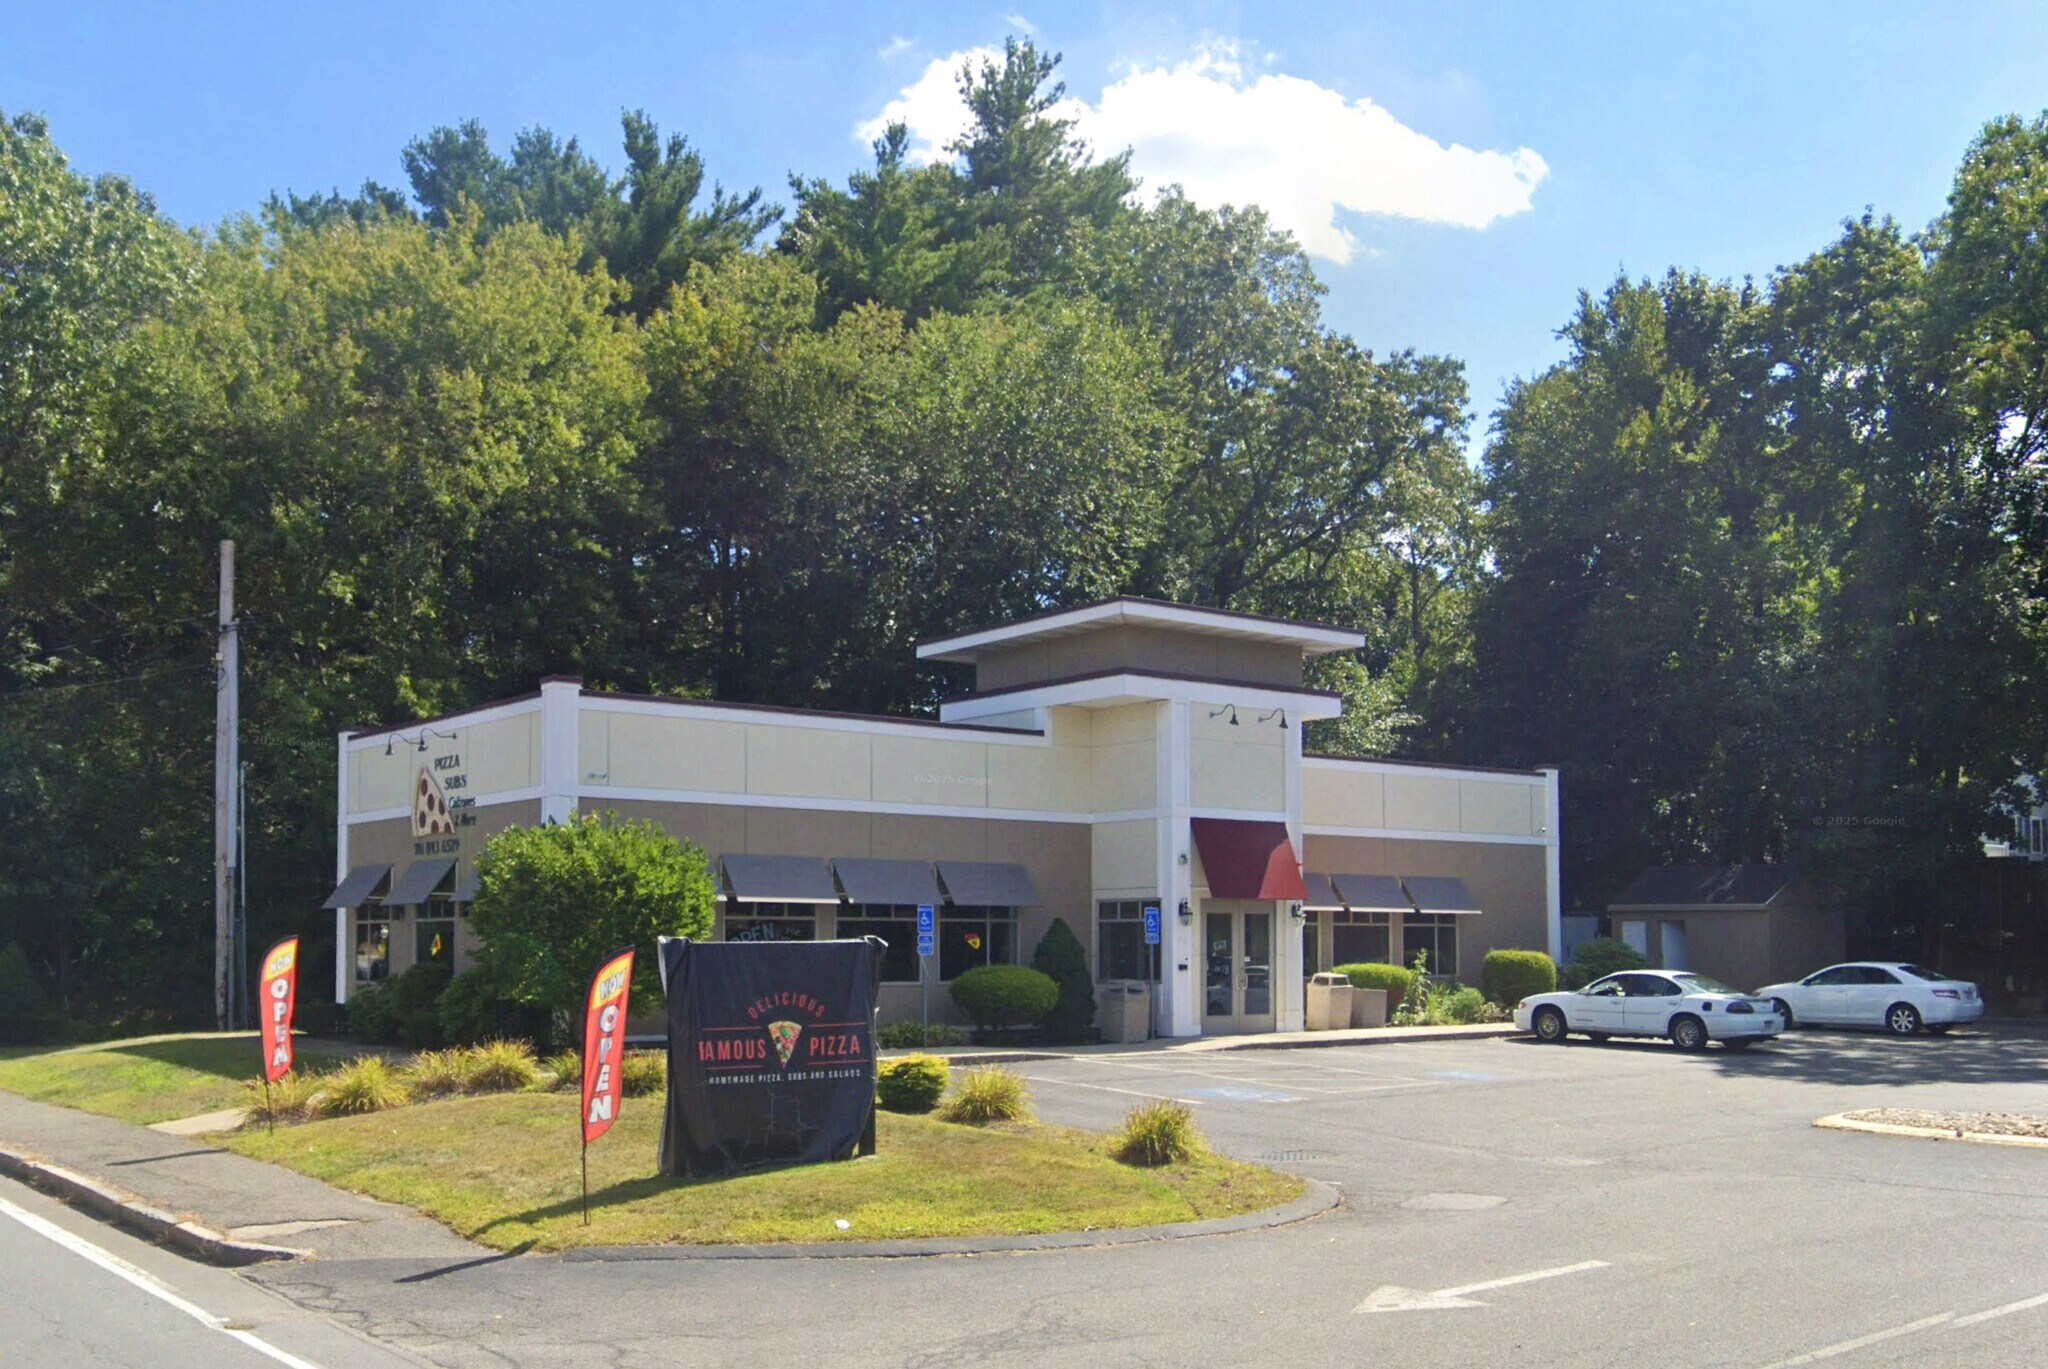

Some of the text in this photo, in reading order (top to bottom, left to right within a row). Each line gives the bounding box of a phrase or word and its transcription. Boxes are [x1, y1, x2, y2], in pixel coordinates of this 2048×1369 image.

[434, 754, 460, 772] PIZZA
[444, 774, 467, 790] SUBS
[271, 953, 290, 971] NOW
[600, 969, 626, 999] NOW
[746, 991, 825, 1019] DELICIOUS
[270, 978, 290, 1067] OPEN
[808, 1034, 861, 1057] PIZZA
[588, 1004, 619, 1123] OPEN
[708, 1074, 755, 1086] HOMEMADE
[788, 1071, 807, 1082] SUBS
[810, 1070, 825, 1080] AND
[828, 1068, 861, 1080] SALADS
